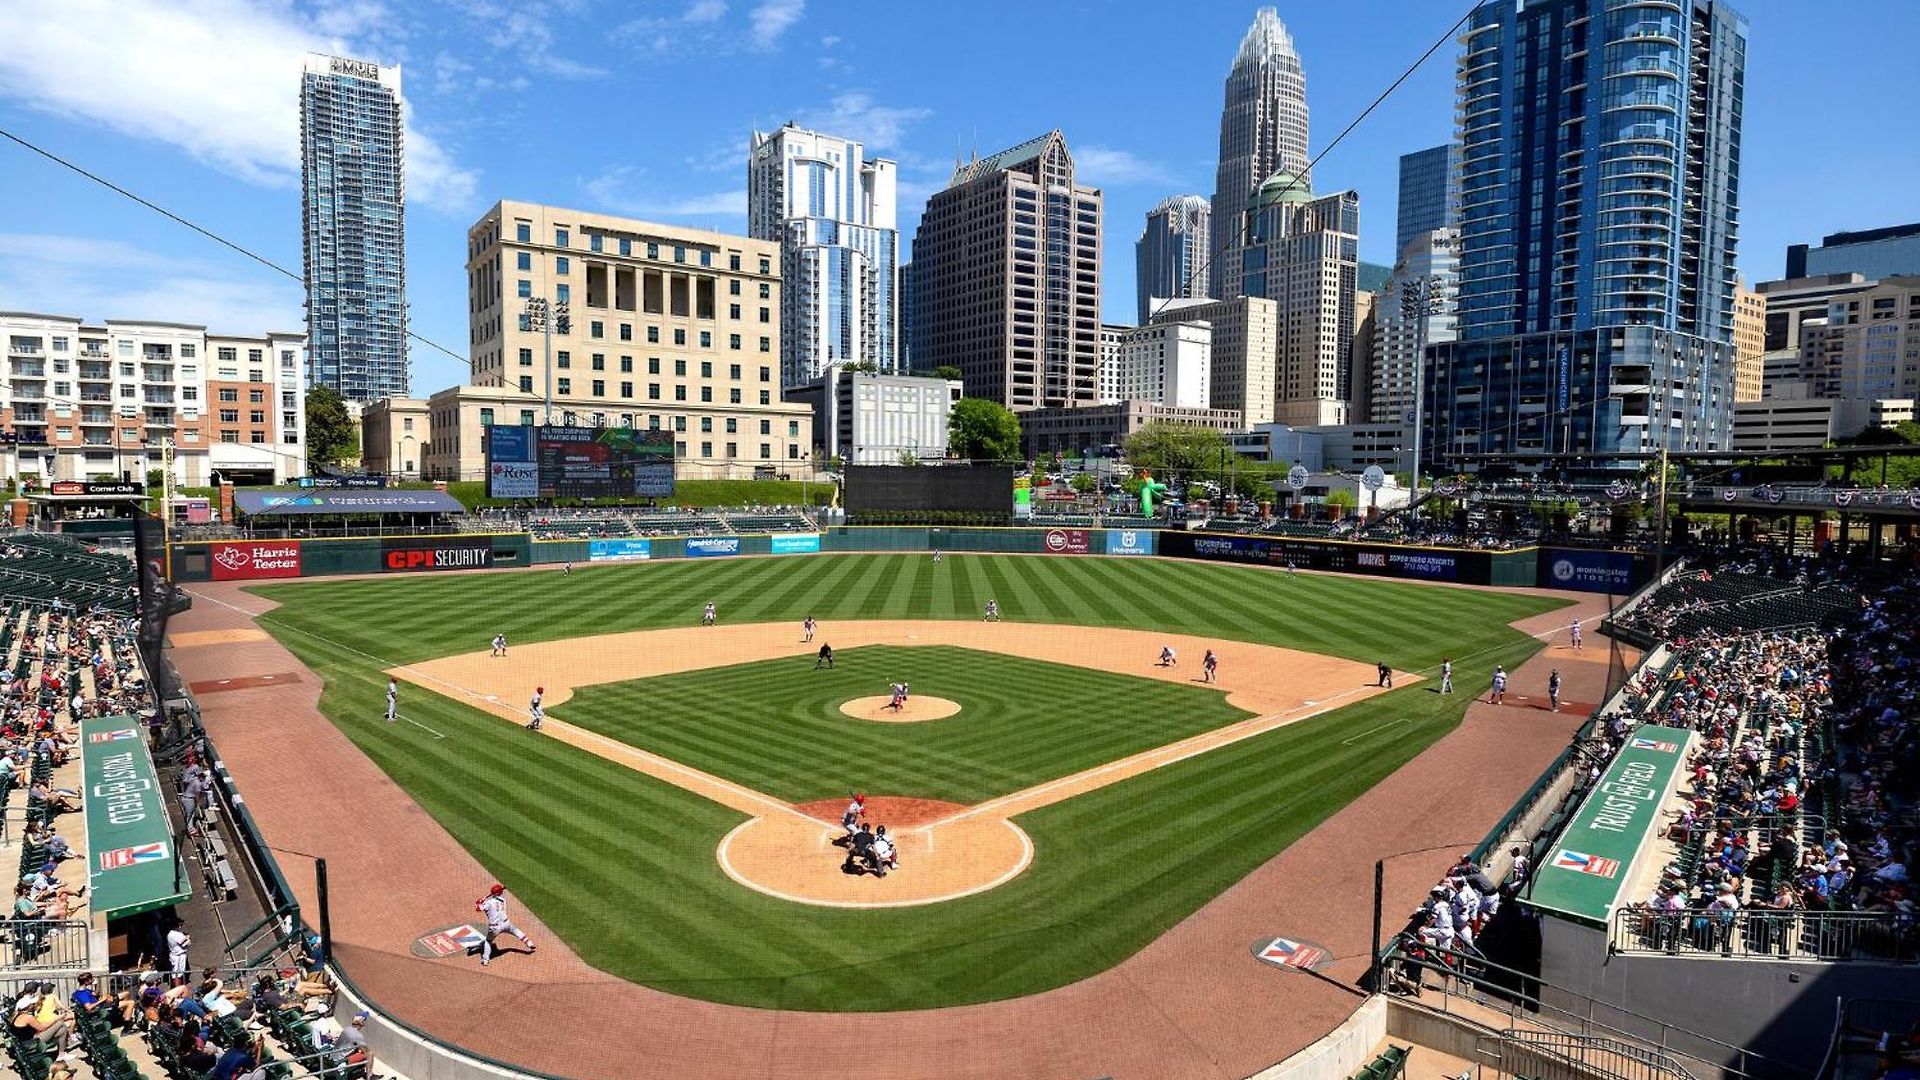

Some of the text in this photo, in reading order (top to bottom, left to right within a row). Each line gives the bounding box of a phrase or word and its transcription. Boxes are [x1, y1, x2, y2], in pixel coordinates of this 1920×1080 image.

[504, 465, 537, 479] Rose
[89, 485, 116, 493] Corner
[117, 485, 135, 493] Club
[252, 547, 297, 558] Harris
[388, 548, 487, 569] CPI SECURITY
[253, 559, 297, 569] Teeter
[1357, 553, 1386, 567] MARVEL
[102, 751, 137, 782] TRUIST
[1589, 795, 1640, 833] TRUIST
[1618, 761, 1657, 787] FIELD
[106, 792, 147, 825] FIELD
